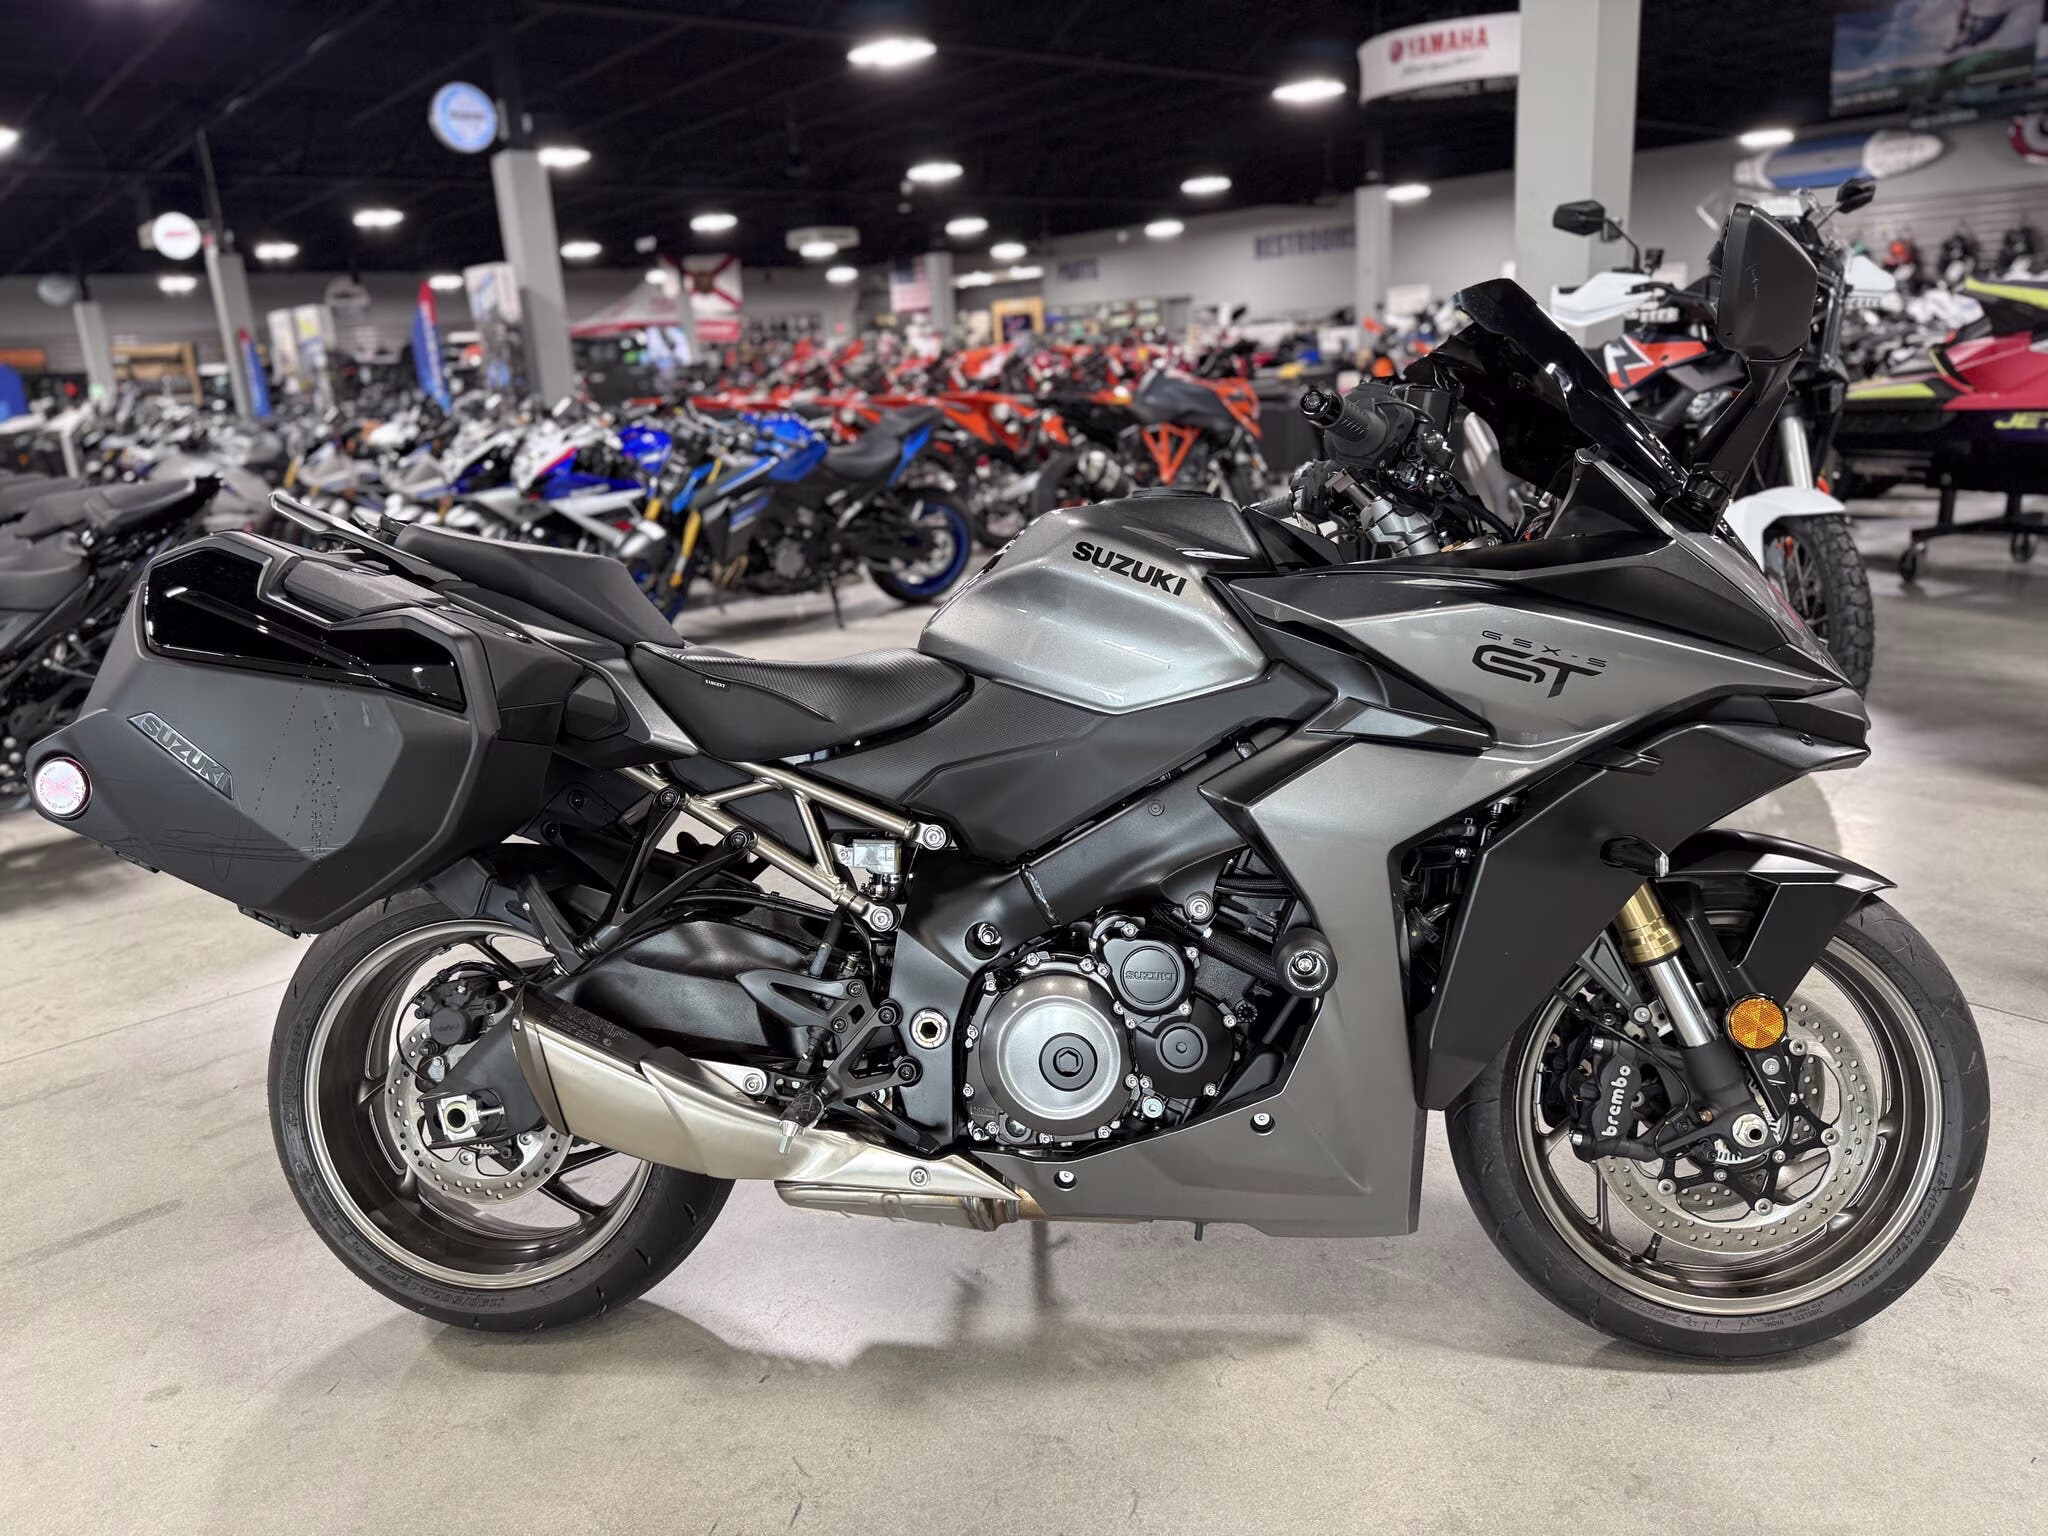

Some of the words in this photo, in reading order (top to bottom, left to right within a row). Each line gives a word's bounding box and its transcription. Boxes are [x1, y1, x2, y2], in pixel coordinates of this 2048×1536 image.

[1406, 27, 1488, 58] YAMAHA
[1072, 541, 1187, 596] SUZUKI
[1472, 644, 1603, 698] GT
[1482, 630, 1607, 668] GSX-S
[141, 715, 230, 792] SUZUKI
[1125, 970, 1175, 982] SUZUKI
[1601, 1065, 1631, 1137] brembo
